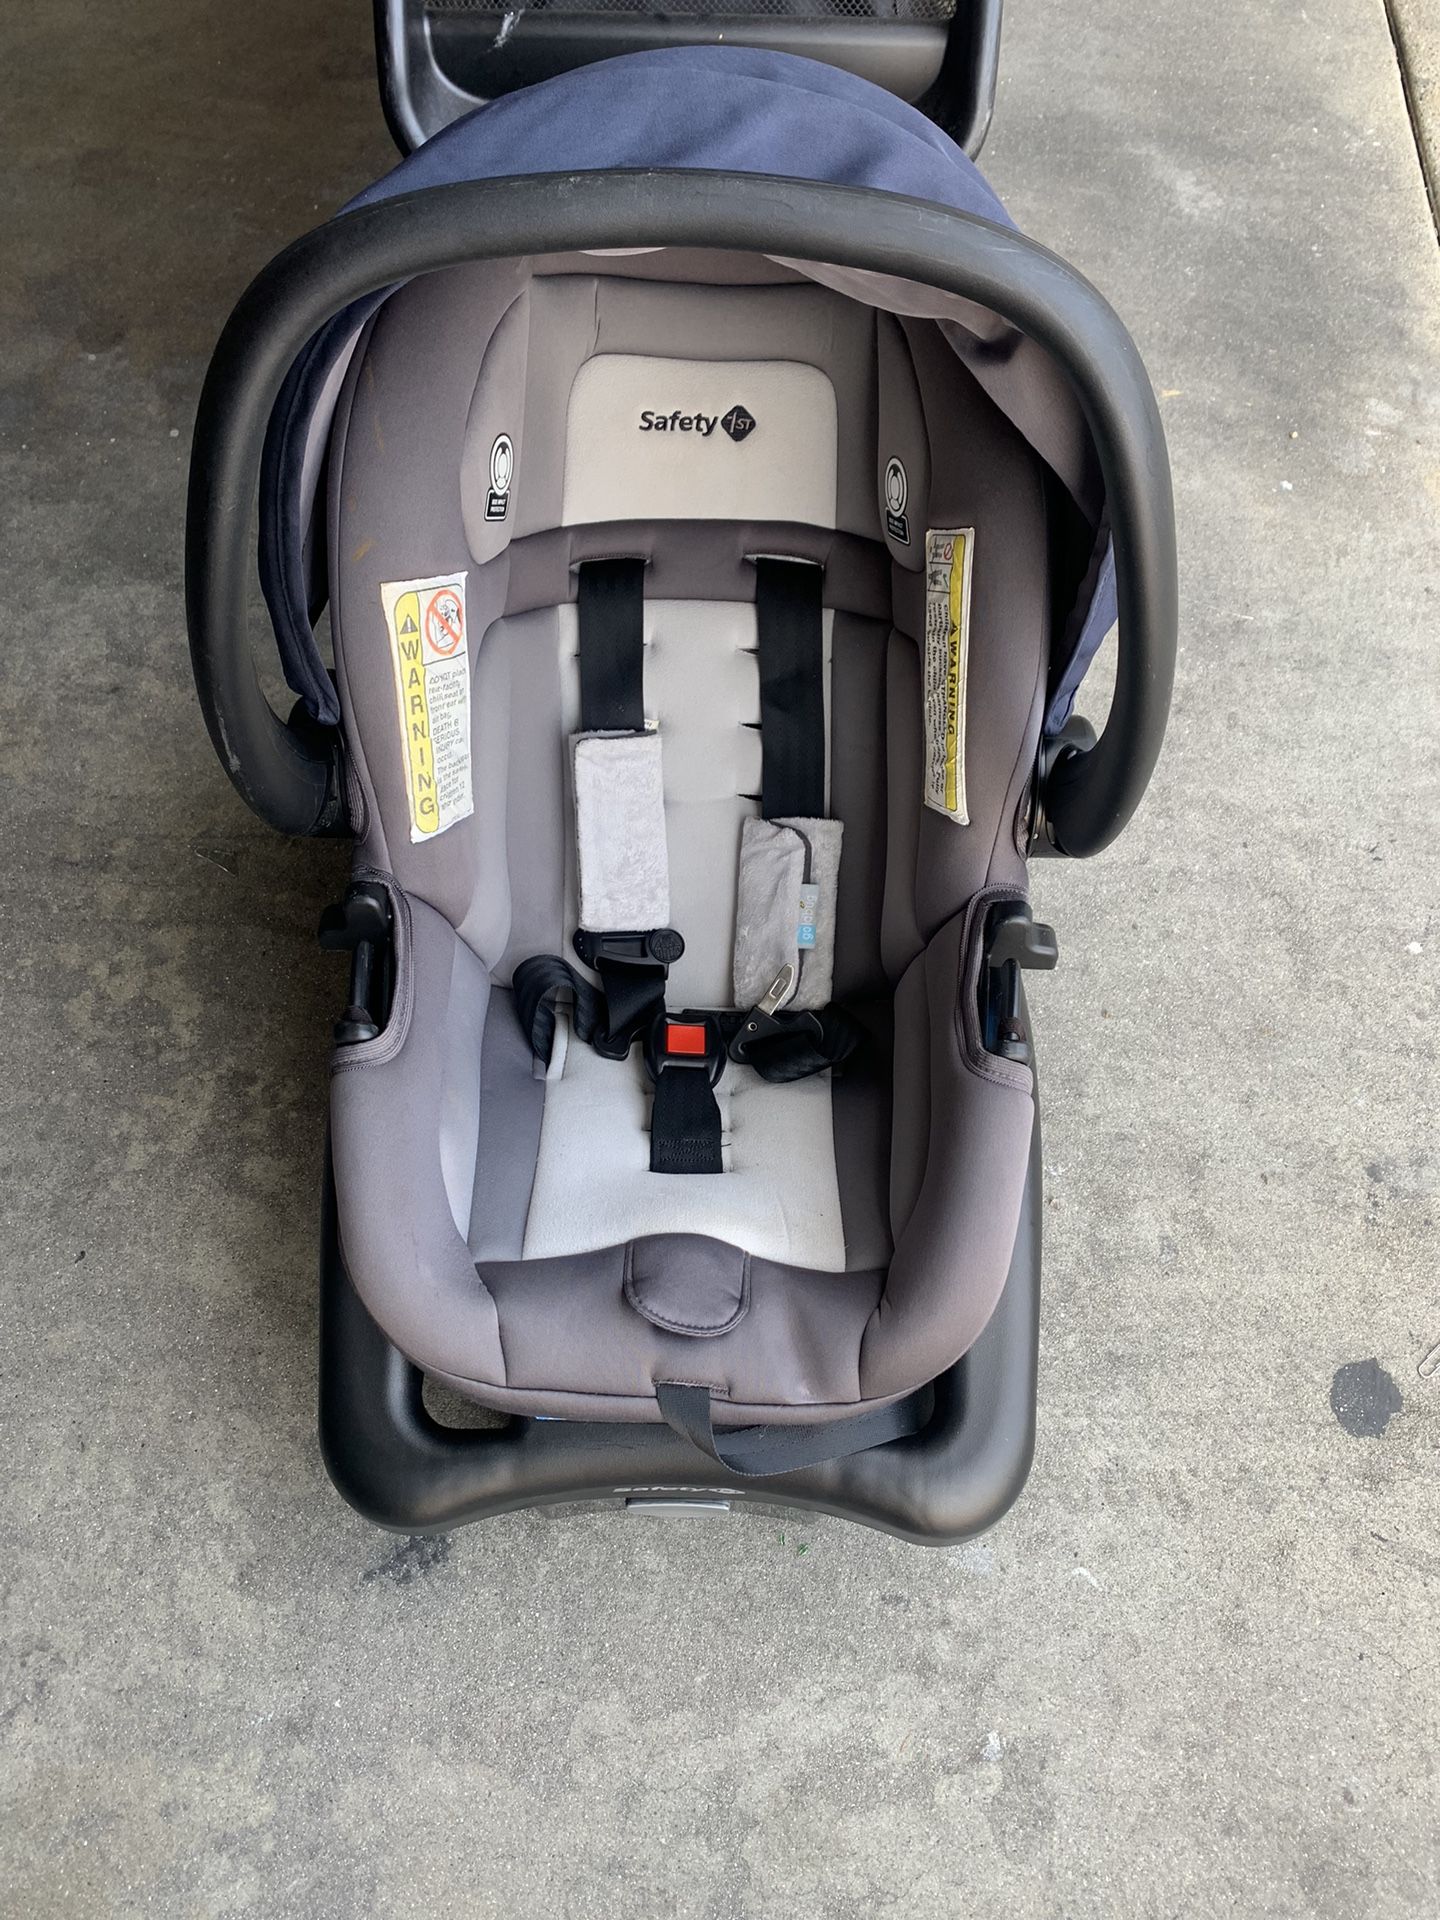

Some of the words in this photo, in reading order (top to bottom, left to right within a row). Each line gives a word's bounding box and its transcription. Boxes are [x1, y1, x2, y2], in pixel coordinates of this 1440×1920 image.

[638, 410, 719, 437] Safety
[948, 640, 958, 736] WARNING
[400, 638, 435, 815] WARNING
[432, 720, 453, 737] DEATH
